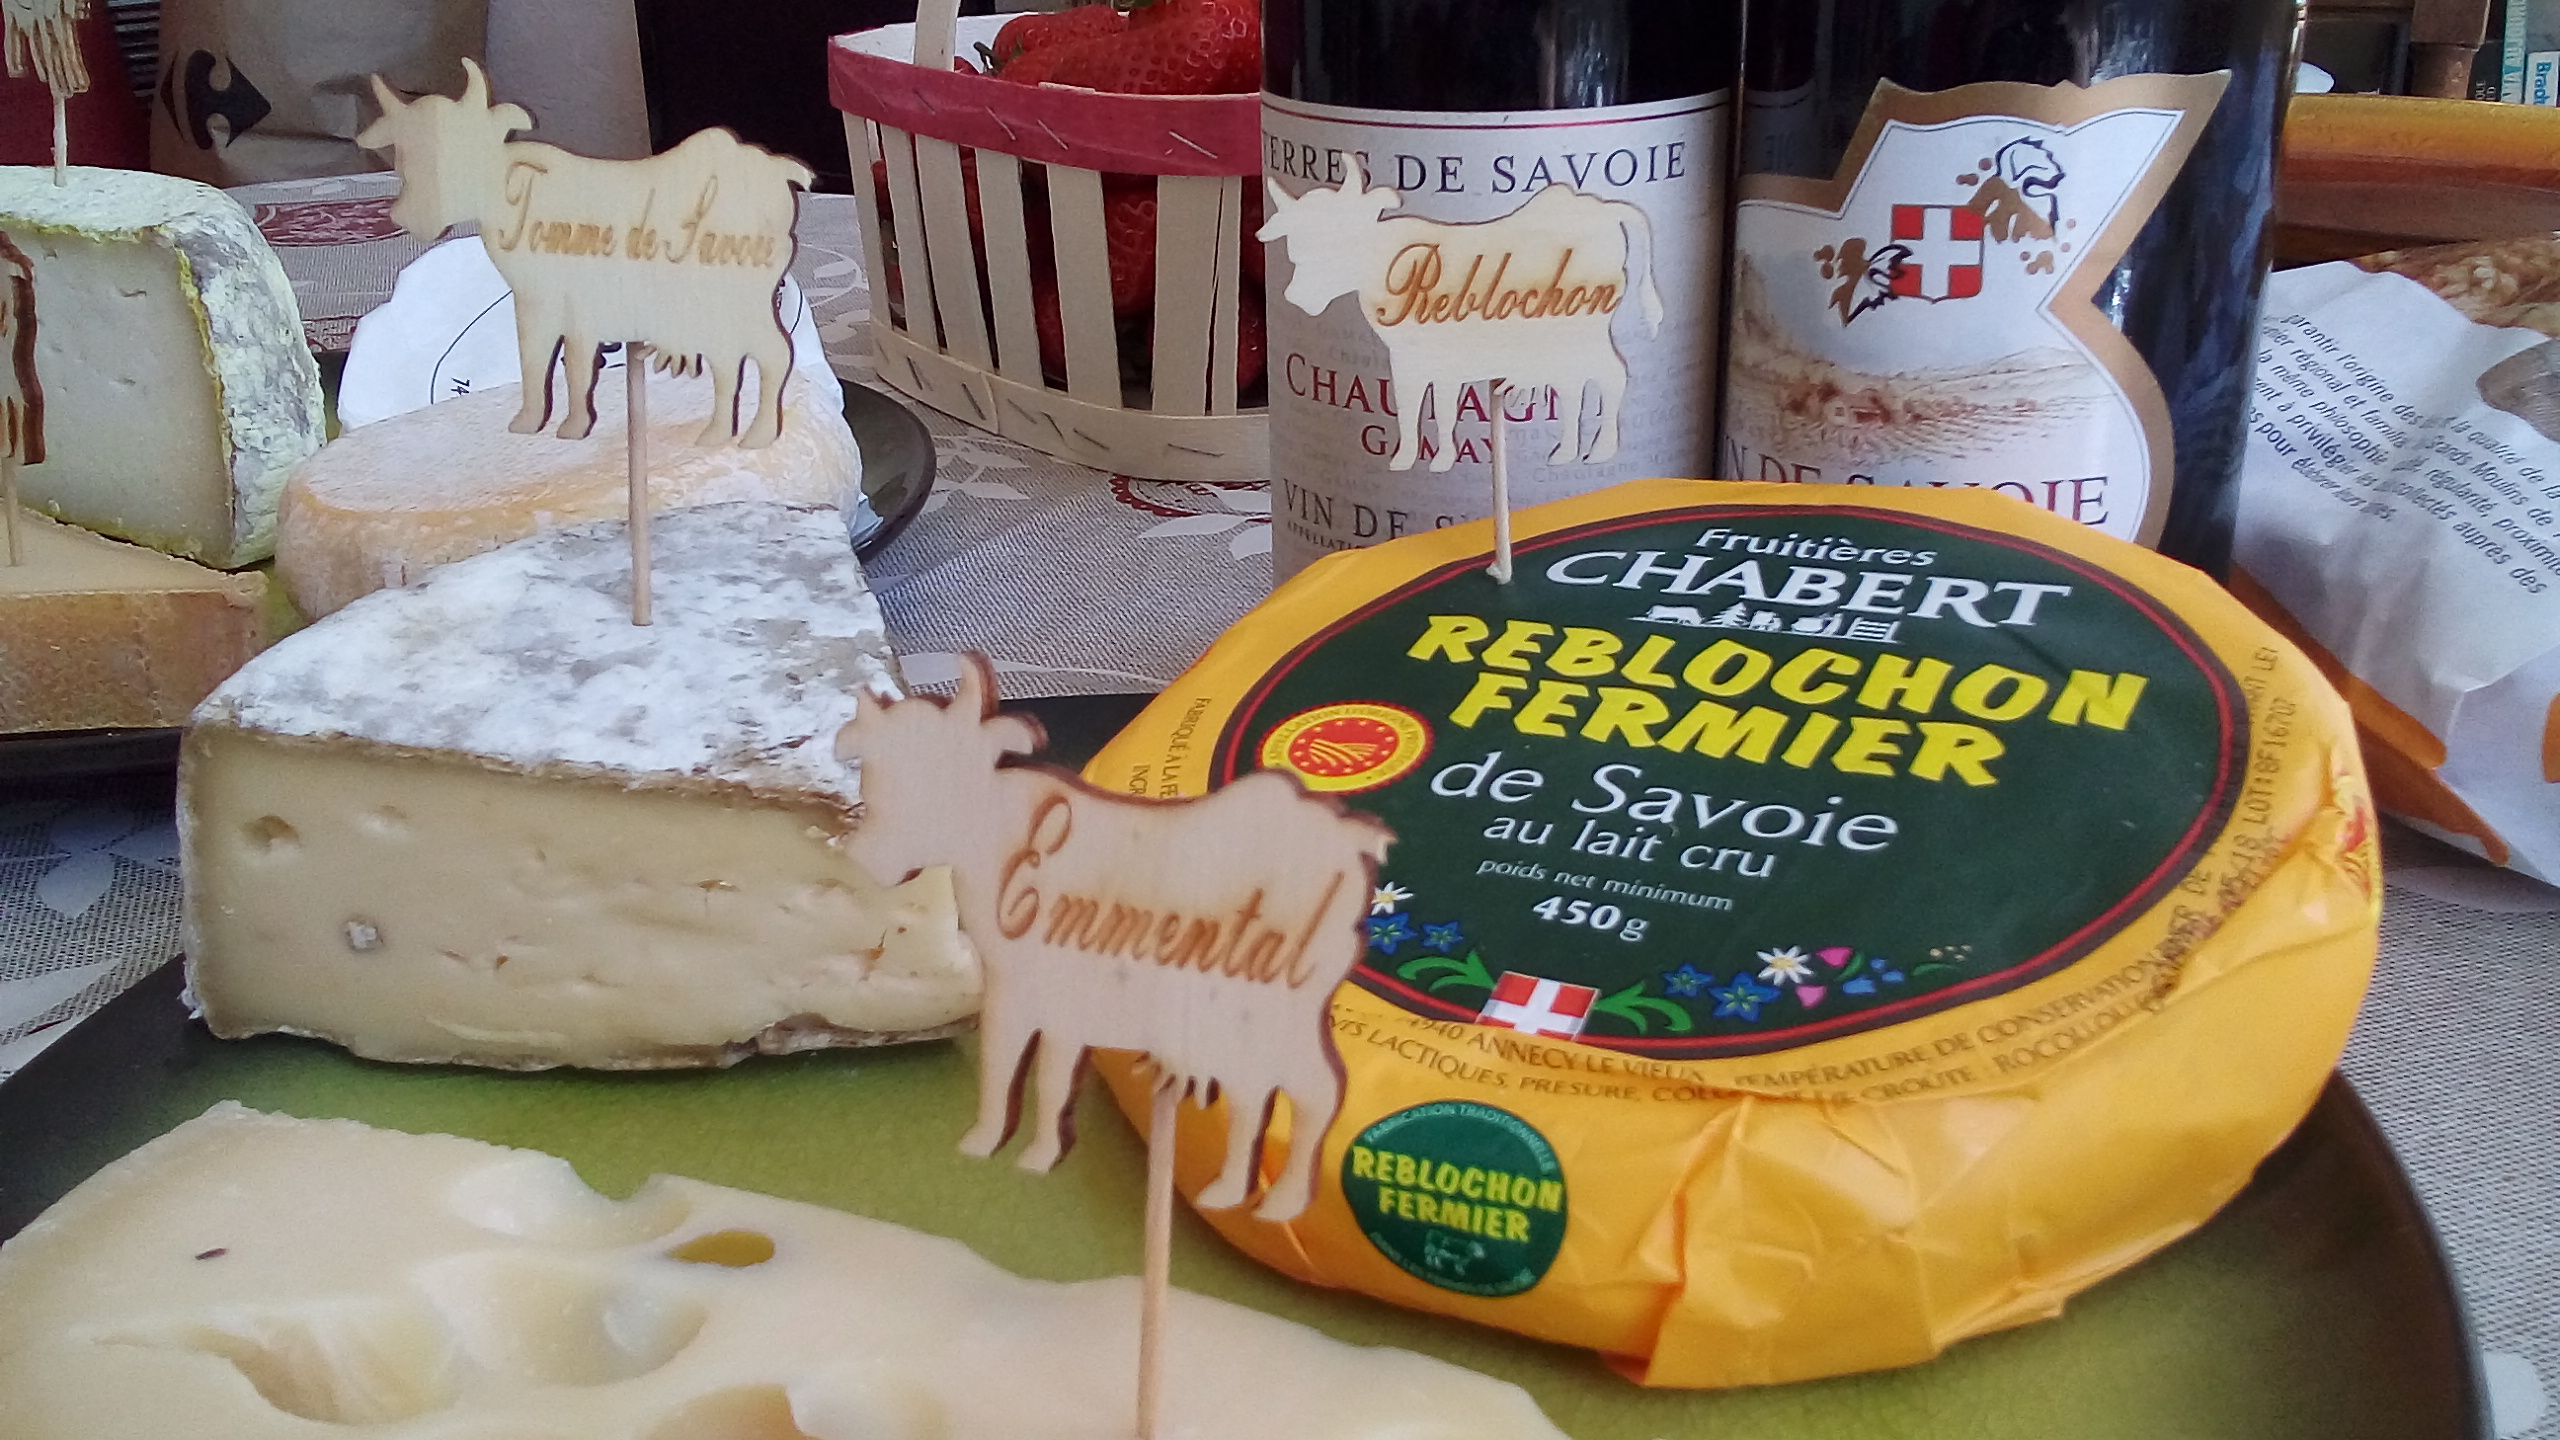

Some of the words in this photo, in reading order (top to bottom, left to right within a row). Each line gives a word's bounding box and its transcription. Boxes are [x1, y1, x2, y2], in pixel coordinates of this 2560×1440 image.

[1394, 153, 1466, 193] DE
[1491, 141, 1687, 194] SAVOIE
[498, 161, 617, 257] Tomme
[625, 184, 658, 260] de
[661, 174, 776, 268] Savoie
[1376, 242, 1622, 328] Reblochon
[2269, 365, 2315, 398] même
[2253, 421, 2298, 456] pour
[2289, 348, 2354, 393] régional
[2342, 394, 2368, 410] et
[2469, 461, 2530, 506] Moulins
[2526, 508, 2554, 527] de
[2336, 354, 2394, 402] l'origine
[2391, 404, 2424, 426] des
[2518, 467, 2545, 483] de
[1283, 478, 1334, 531] VIN
[1694, 525, 1939, 570] Fruitières
[2452, 521, 2513, 565] auprès
[2508, 567, 2548, 594] des
[1544, 549, 2073, 630] CHABERT
[1406, 612, 2152, 732] REBLOCHON
[1448, 671, 2006, 789] FERMIER
[1429, 750, 1546, 804] de
[1570, 761, 1902, 852] Savoie
[1482, 812, 1551, 846] au
[1571, 816, 1665, 863] lait
[1680, 842, 1779, 880] cru
[996, 792, 1316, 989] Emmental
[1475, 853, 1548, 882] poids
[1553, 868, 1597, 891] net
[1602, 873, 1734, 913] minimum
[1531, 894, 1651, 943] 450g
[1366, 1028, 1509, 1090] LACTIQUES,
[1467, 1031, 1579, 1071] ANNECY
[1586, 1053, 1615, 1074] LE
[1933, 1031, 1975, 1058] DE
[1352, 1144, 1564, 1213] REBLOCHON
[1377, 1185, 1531, 1243] FERMIER
